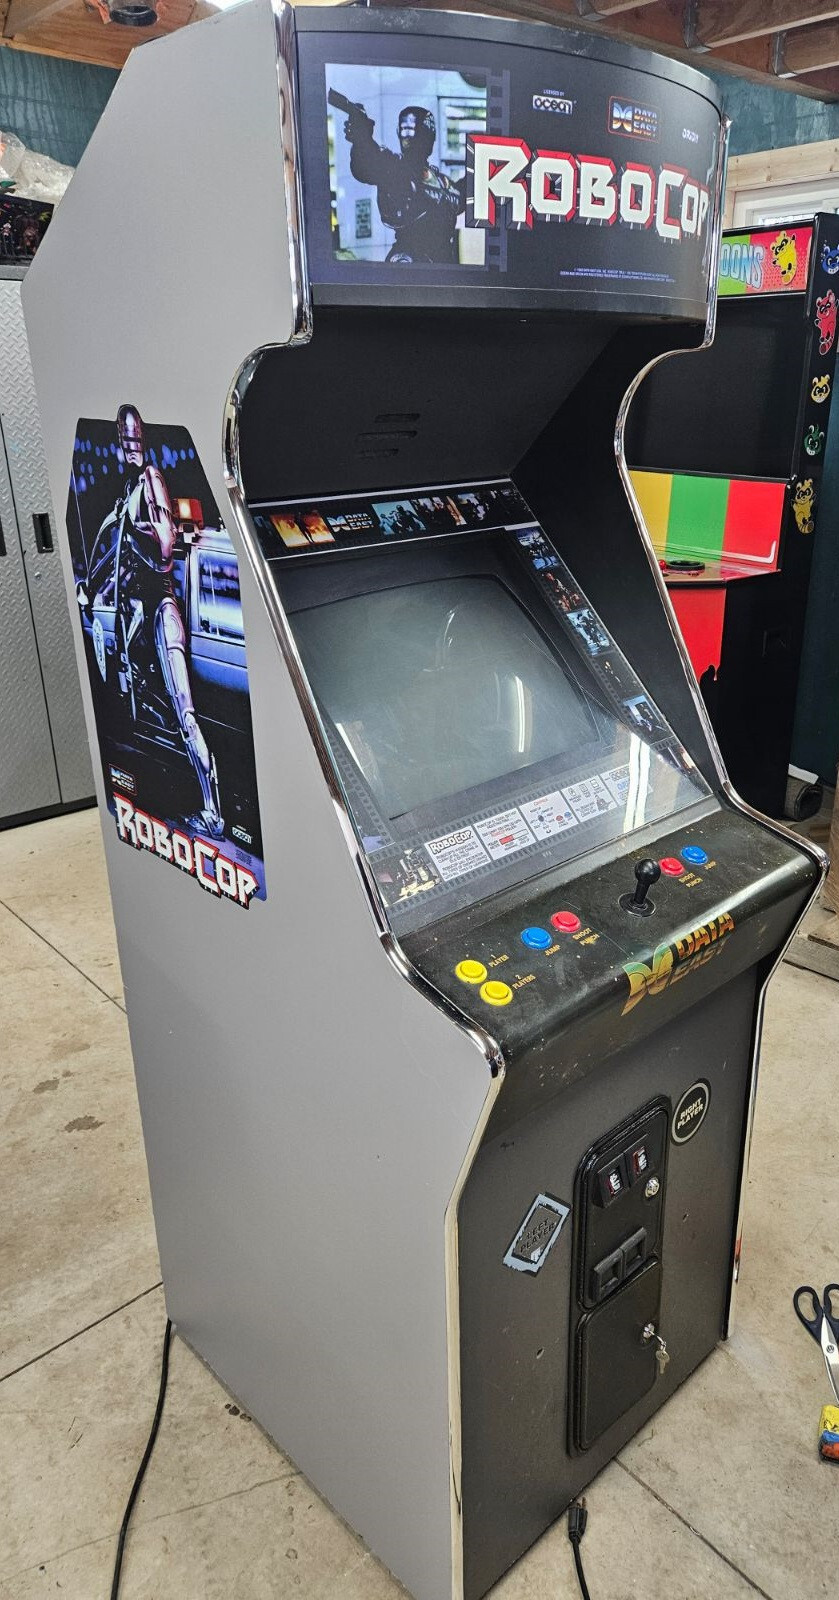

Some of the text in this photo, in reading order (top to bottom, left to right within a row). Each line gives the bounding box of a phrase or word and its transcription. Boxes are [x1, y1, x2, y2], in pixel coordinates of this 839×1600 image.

[634, 107, 658, 124] DATA
[344, 512, 370, 523] DATA
[348, 519, 375, 530] EAST
[572, 927, 592, 940] SHOOT
[579, 933, 601, 946] PUNCH
[675, 913, 735, 959] DATA
[544, 944, 562, 957] JUMP
[488, 954, 510, 968] PLAYER
[674, 936, 729, 982] EAST
[511, 974, 537, 990] PLAYERS
[677, 1103, 704, 1130] PLAYER
[680, 1097, 702, 1120] RIGHT
[526, 1217, 549, 1240] LEFT
[520, 1222, 557, 1253] PLAYER
